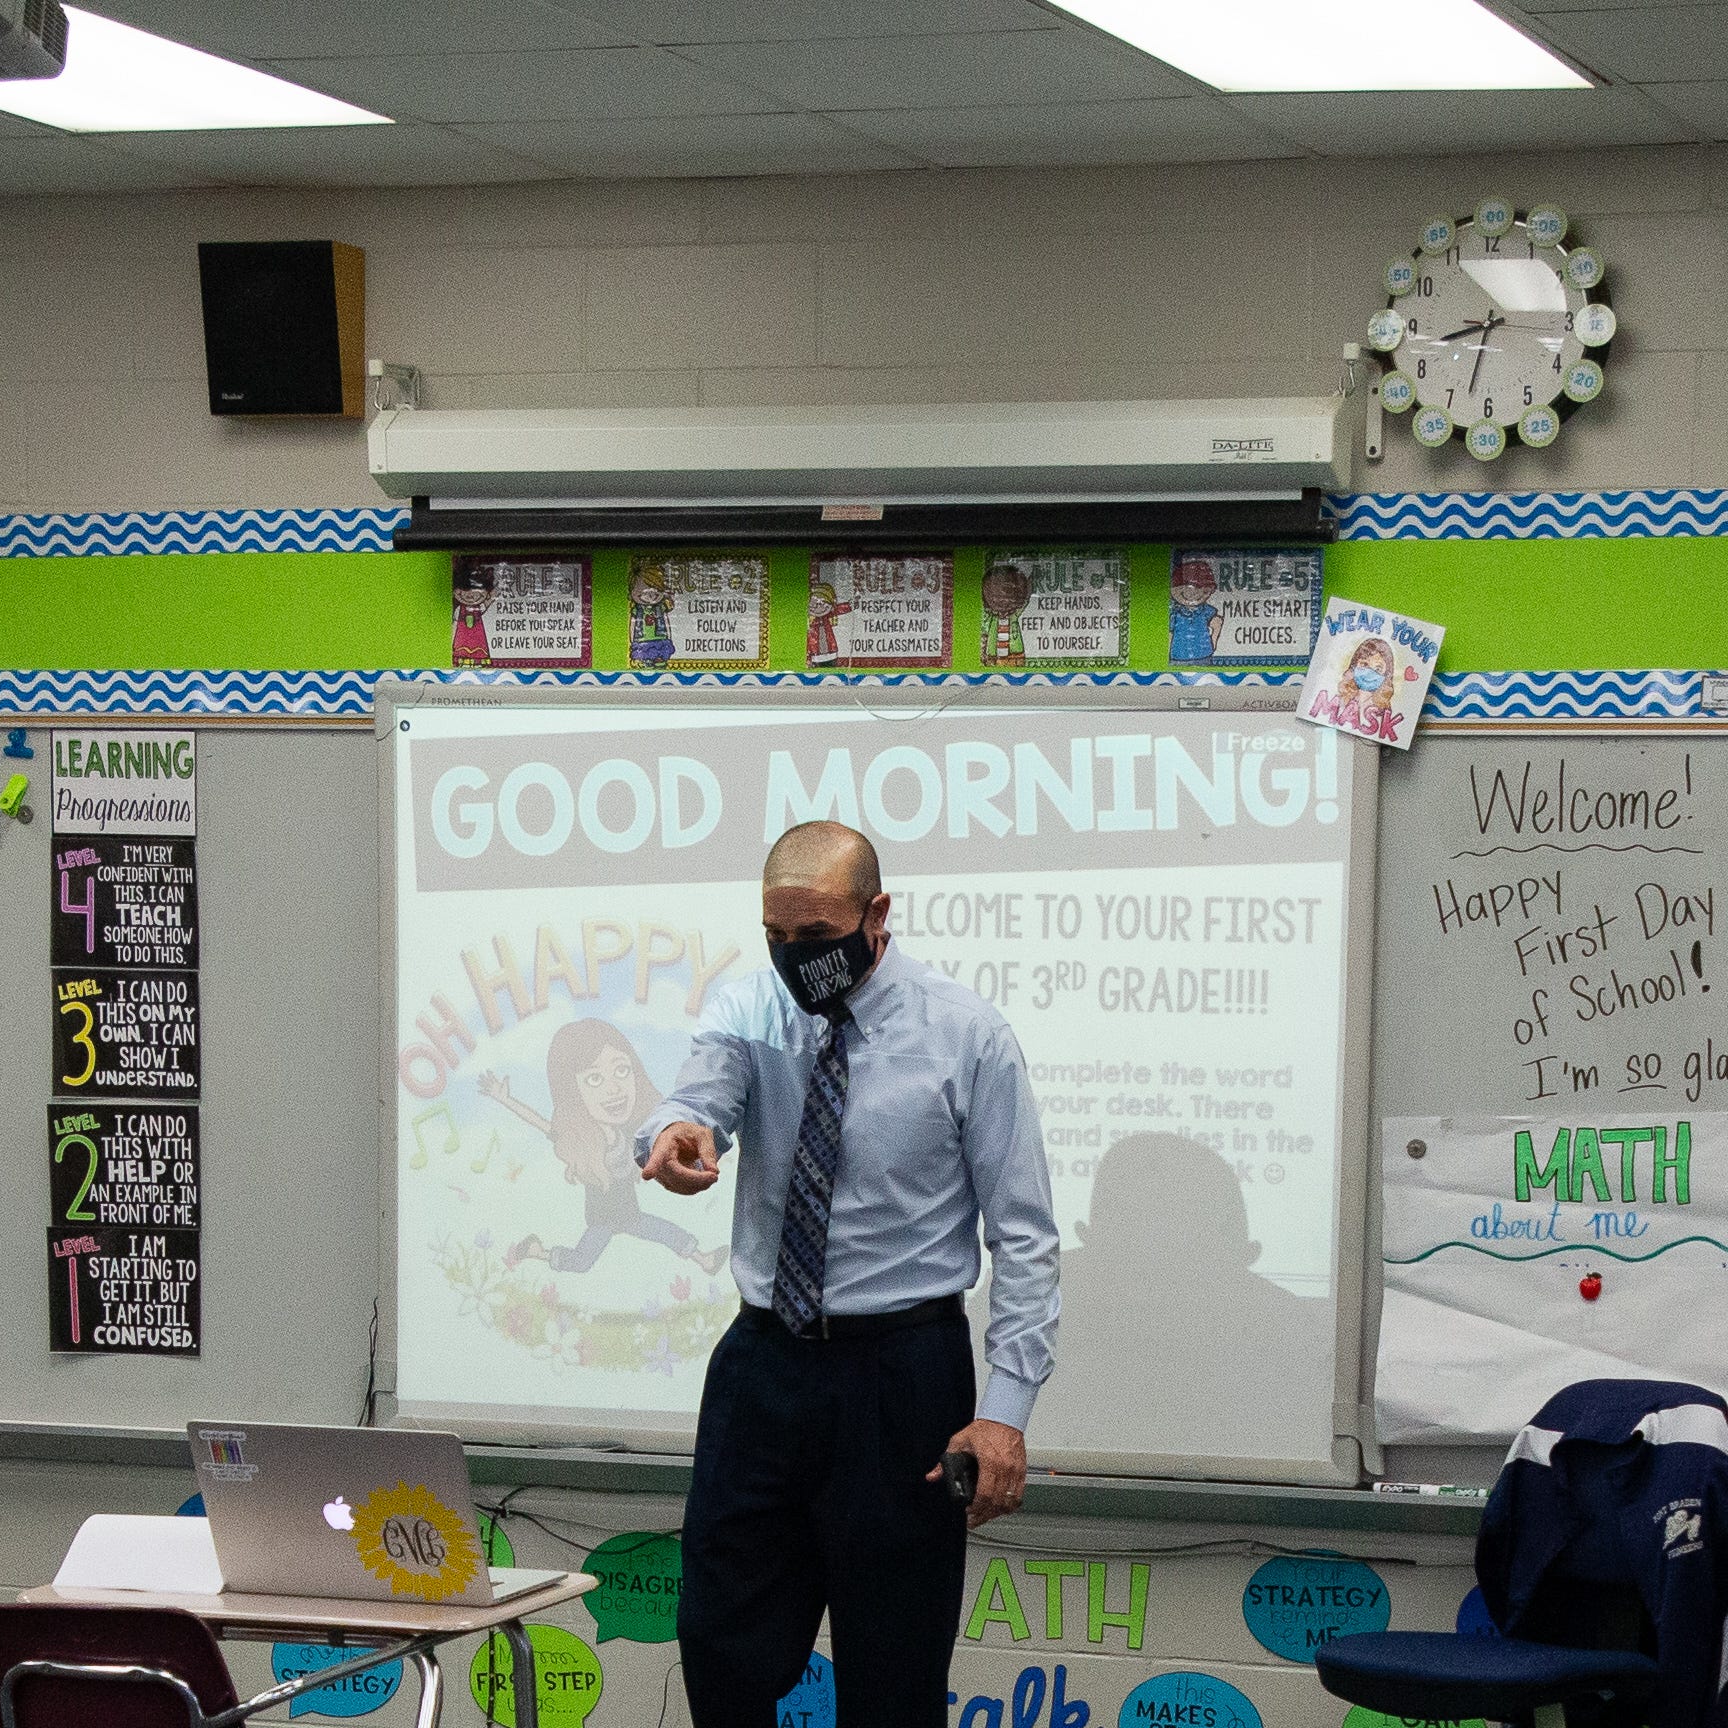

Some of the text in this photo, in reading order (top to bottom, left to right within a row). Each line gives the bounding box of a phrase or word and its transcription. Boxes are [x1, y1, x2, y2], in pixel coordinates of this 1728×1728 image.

[1417, 359, 1427, 379] 8
[1483, 398, 1493, 418] 6
[1424, 418, 1445, 434] 35
[1530, 419, 1550, 433] 25
[687, 600, 748, 614] LISTEN AND
[1222, 599, 1310, 618] MAKE SMART
[696, 620, 737, 634] FOLLOW
[1234, 626, 1297, 645] CHOICES.
[1325, 609, 1440, 664] WEAR YOUR
[431, 696, 503, 708] PROMETHEAN
[1309, 690, 1405, 742] MASK
[55, 739, 194, 780] LEARNING
[430, 726, 1340, 859] GOOD MORNING!
[1469, 753, 1693, 834] Welcome!
[56, 787, 194, 831] Progressions
[57, 847, 102, 871] LEVEL
[123, 845, 174, 865] I'M VERY
[97, 865, 194, 884] CONFIDENT WITH
[114, 884, 185, 904] THIS. I CAN
[1432, 870, 1562, 934] Happy
[60, 871, 95, 955] 4
[116, 903, 182, 927] TEACH
[1035, 893, 1323, 946] TO YOUR FIRST
[104, 926, 193, 945] SOMEONE HOW
[1513, 883, 1715, 977] First Day
[115, 945, 187, 964] TO DO THIS.
[798, 948, 849, 984] PIONEER
[461, 917, 742, 1036] HAPPY
[974, 959, 1270, 1016] OF 3RD GRADE!!!!
[1513, 940, 1712, 1045] of School!
[1159, 1061, 1293, 1090] the word
[1524, 1055, 1600, 1102] I'm
[1625, 1051, 1664, 1085] so
[1105, 1094, 1275, 1122] desk. There
[1513, 1120, 1693, 1206] MATH
[1470, 1203, 1651, 1244] about me
[1247, 1583, 1383, 1610] STRATEGY
[544, 1672, 597, 1692] STEP
[1135, 1701, 1218, 1728] MAKES
